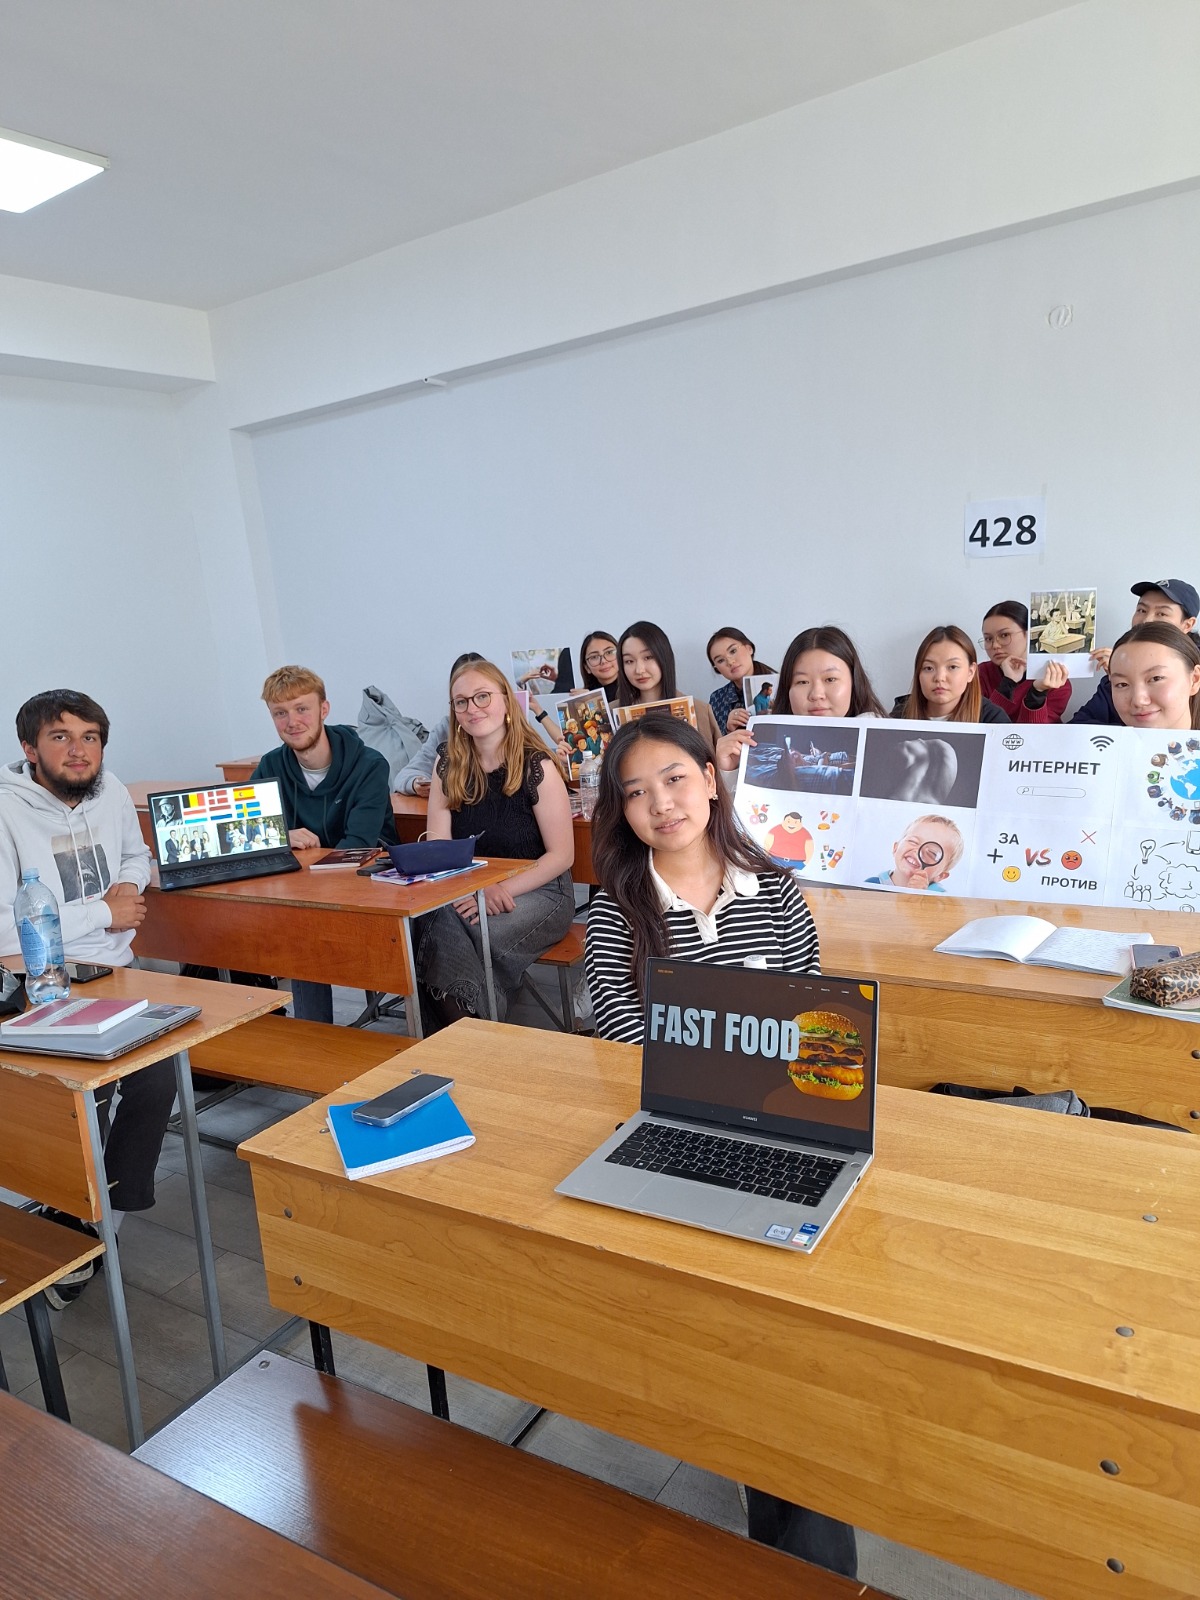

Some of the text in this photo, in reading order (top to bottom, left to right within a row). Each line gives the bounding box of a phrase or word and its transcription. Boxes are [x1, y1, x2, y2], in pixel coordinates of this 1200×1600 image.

[968, 514, 1037, 548] 428
[1008, 760, 1101, 775] ИНТЕРНЕТ
[998, 832, 1020, 845] ЗА
[1025, 847, 1052, 867] VS
[1041, 875, 1098, 890] ПРОТИВ
[650, 1003, 800, 1062] FAST FOOD
